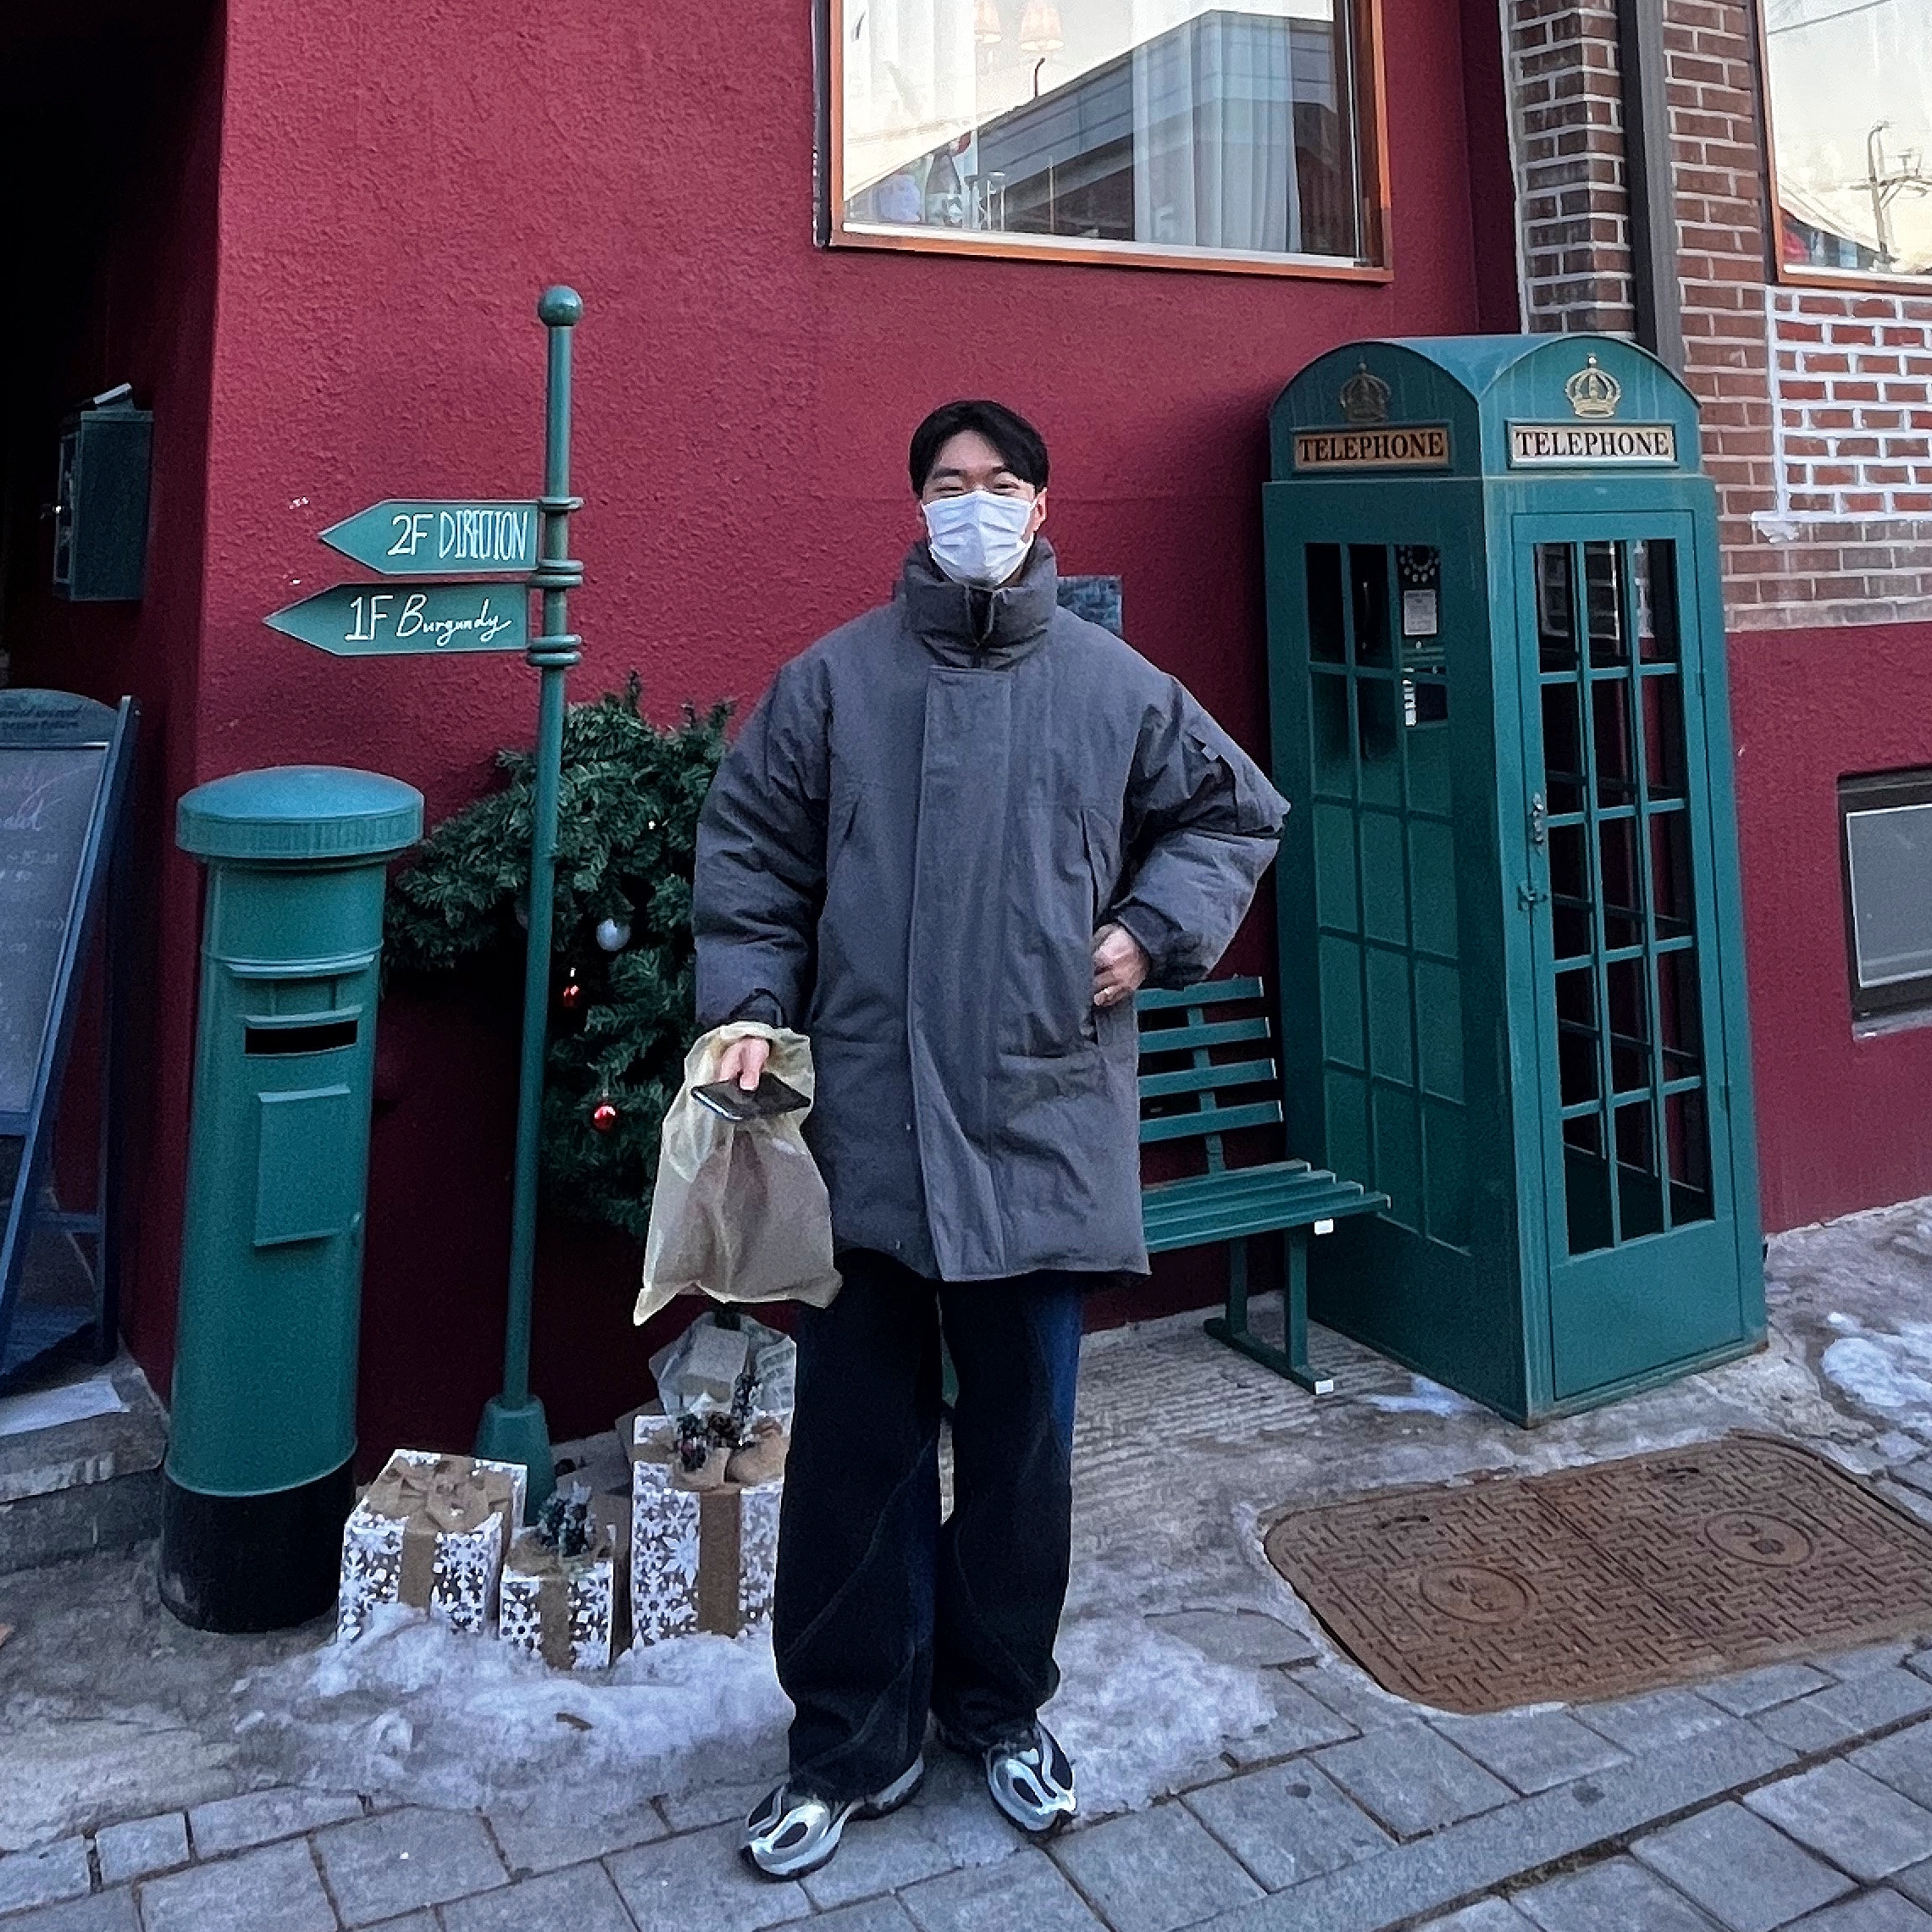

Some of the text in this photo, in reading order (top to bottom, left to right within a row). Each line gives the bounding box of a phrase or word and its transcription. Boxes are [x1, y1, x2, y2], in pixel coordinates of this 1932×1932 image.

[1298, 431, 1445, 462] TELEPHONE
[1515, 431, 1670, 457] TELEPHONE
[386, 512, 435, 556] 2F
[344, 593, 512, 647] 1F Burgundy
